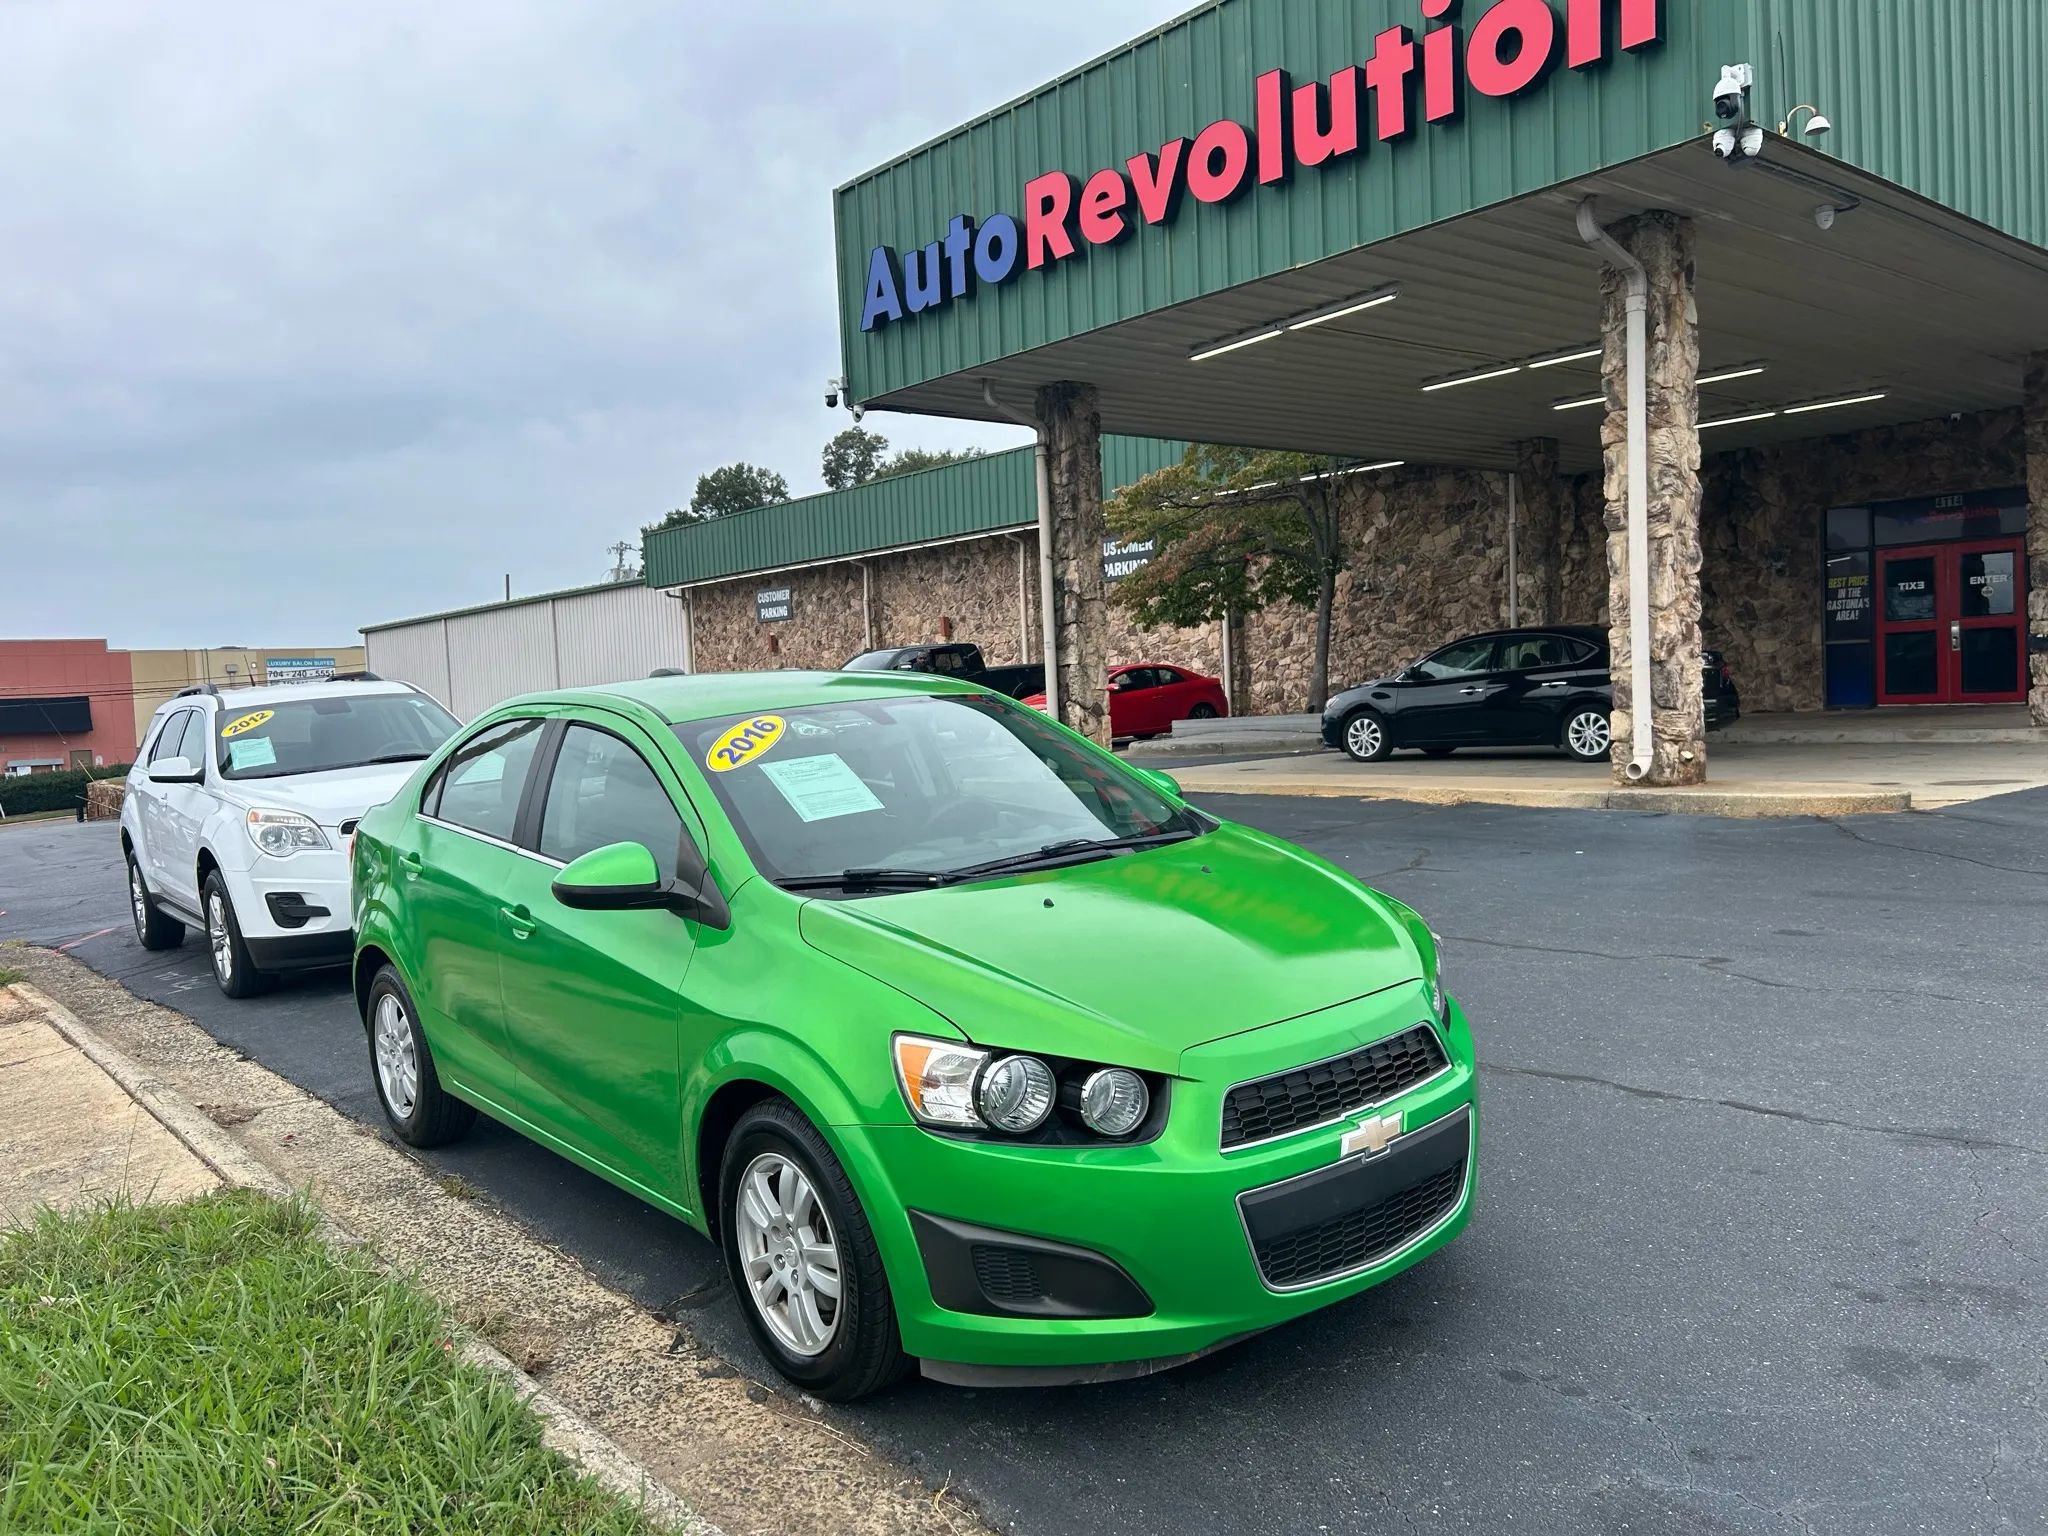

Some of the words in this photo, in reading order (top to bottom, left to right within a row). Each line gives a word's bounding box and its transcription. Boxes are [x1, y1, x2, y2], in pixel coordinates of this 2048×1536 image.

[1102, 540, 1153, 557] USTOMER
[1828, 576, 1847, 589] BEST
[1848, 575, 1869, 587] PRICE
[1969, 574, 2008, 585] ENTER
[757, 589, 790, 604] CUSTOMER
[1837, 588, 1846, 599] IN
[1847, 587, 1862, 598] THE
[1826, 597, 1870, 611] GASTONIA'S
[760, 605, 788, 619] PARKING
[1835, 610, 1859, 621] AREA!
[229, 713, 269, 733] 2012
[717, 719, 777, 765] 2016
